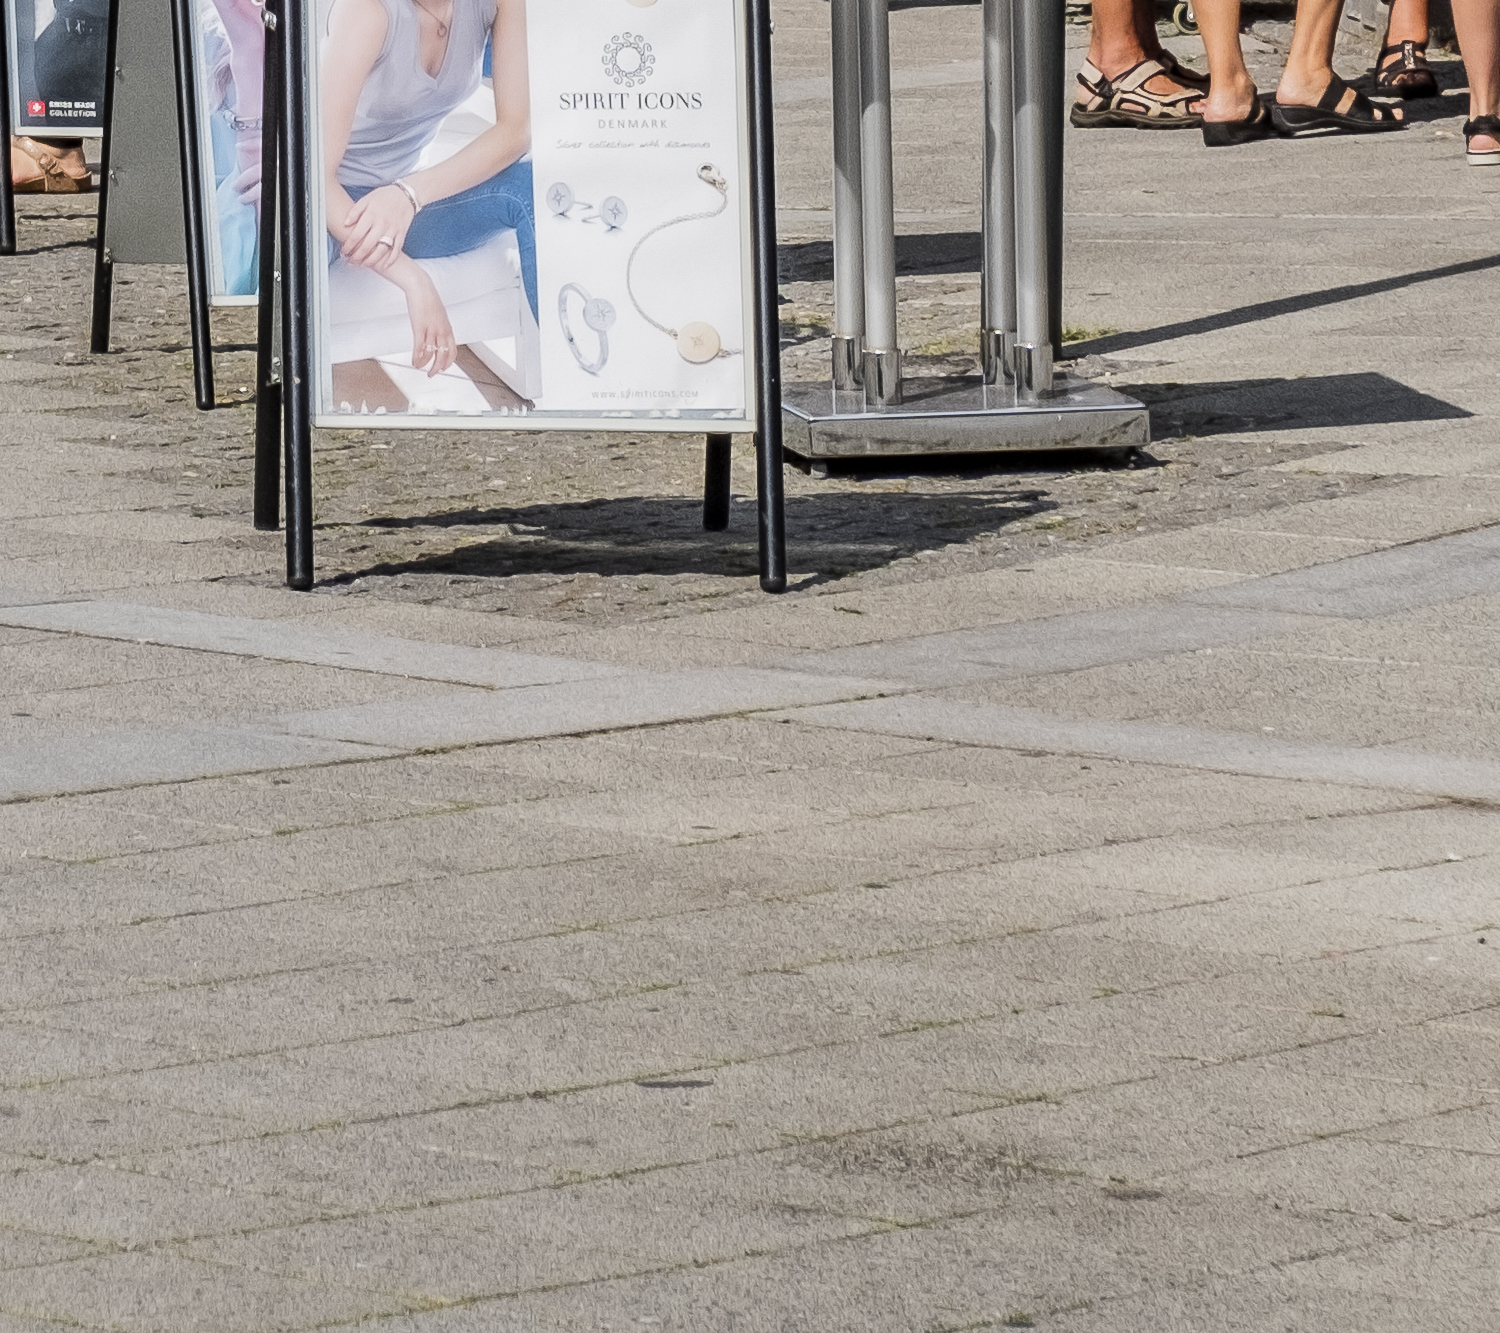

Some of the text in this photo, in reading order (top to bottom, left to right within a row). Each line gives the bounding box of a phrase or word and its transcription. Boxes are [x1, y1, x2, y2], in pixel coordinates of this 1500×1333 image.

[559, 91, 703, 111] SPIRIT ICONS
[597, 118, 668, 130] DENMARK
